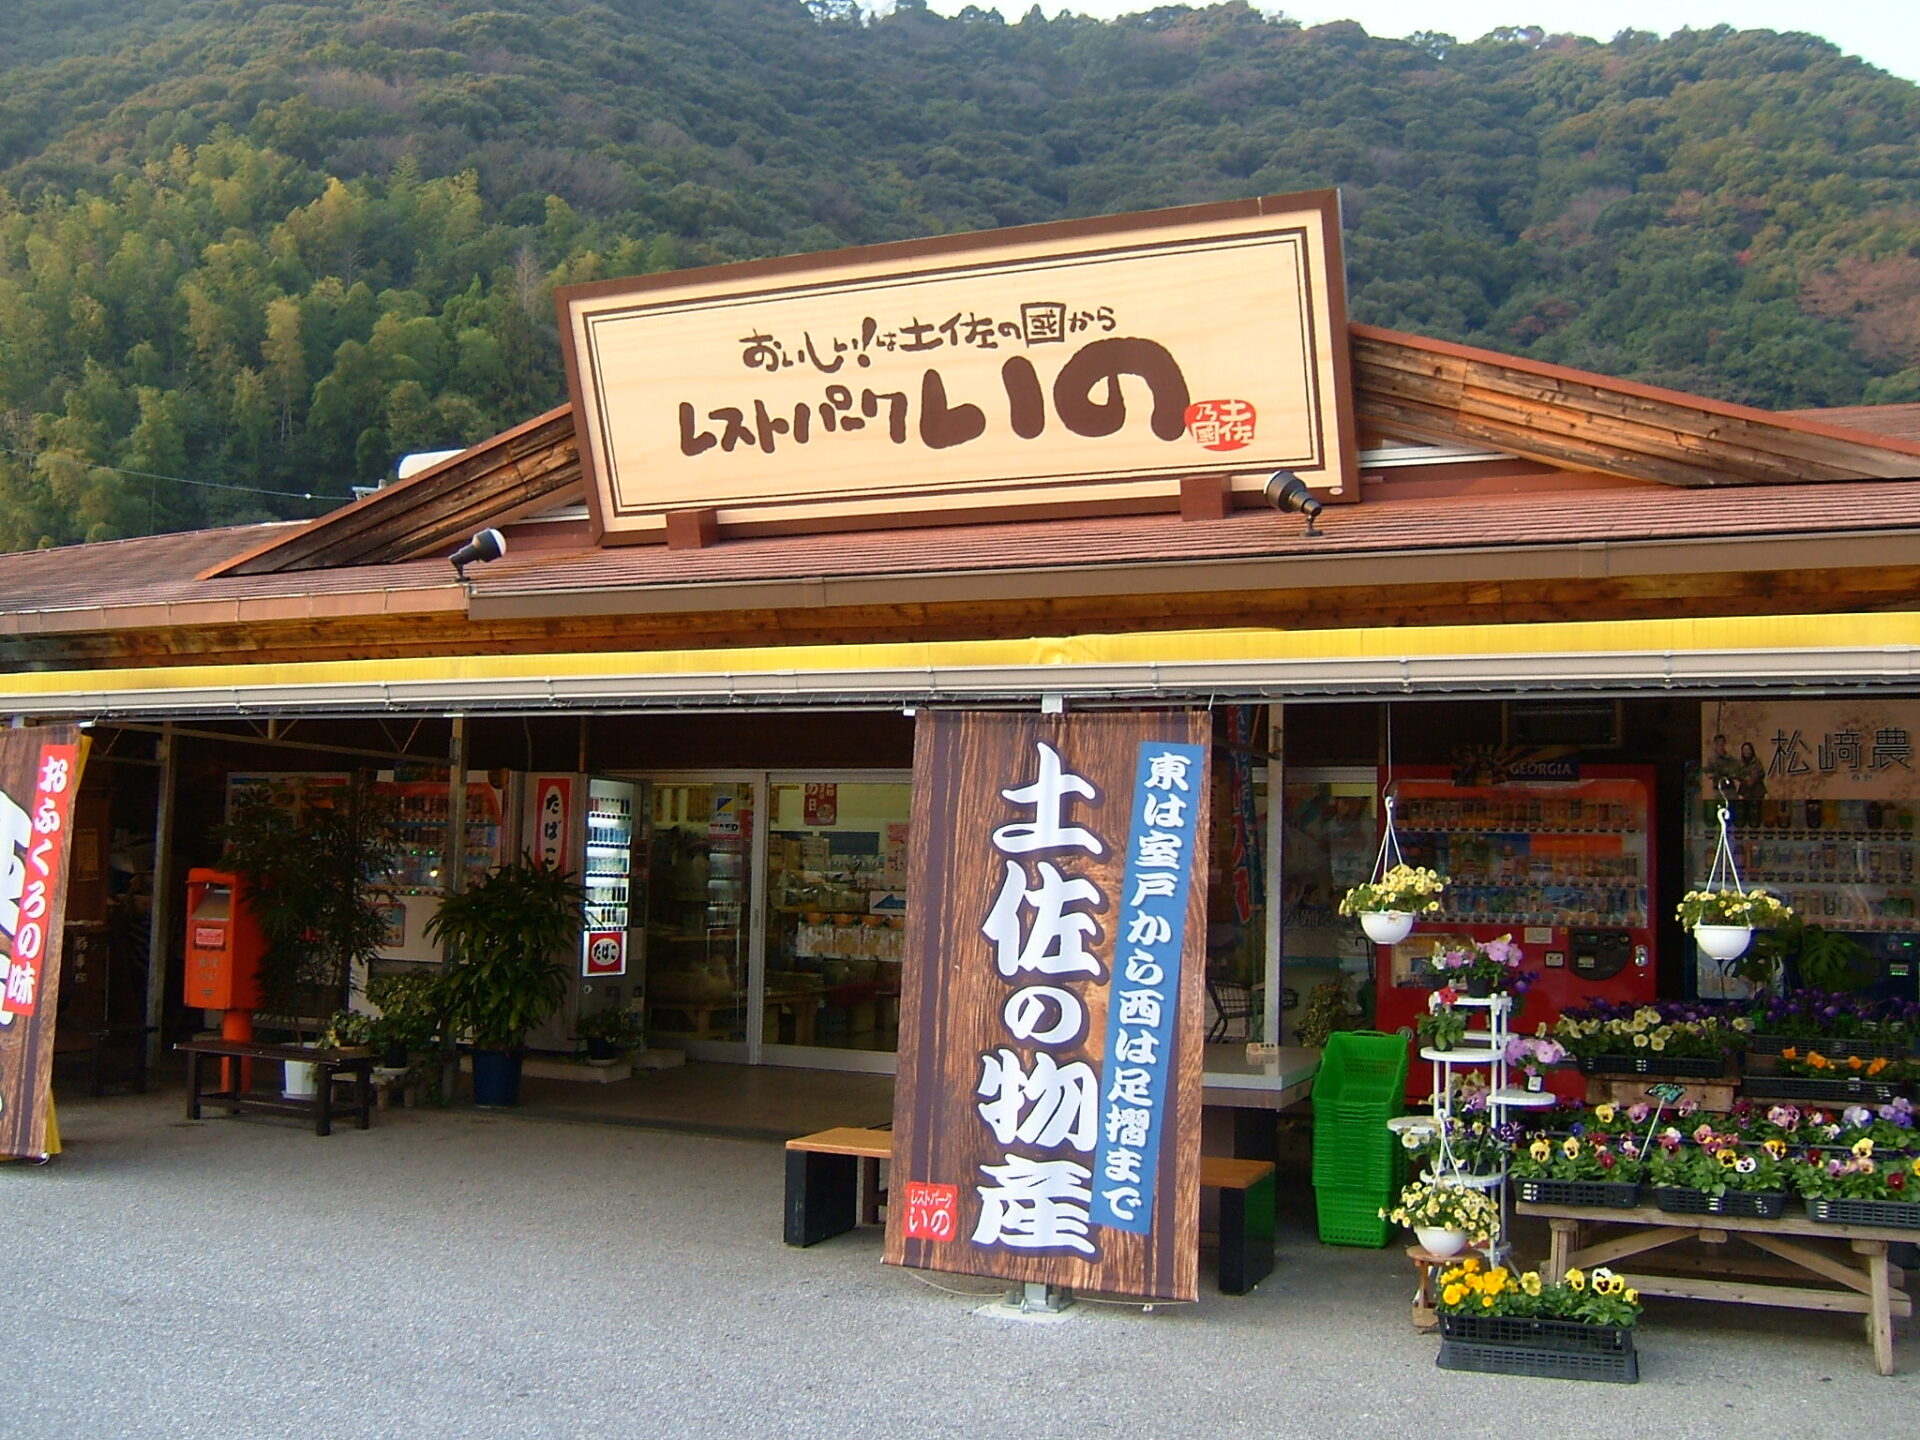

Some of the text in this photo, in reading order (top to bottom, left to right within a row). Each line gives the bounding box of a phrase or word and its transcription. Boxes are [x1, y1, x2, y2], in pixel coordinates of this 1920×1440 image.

[680, 336, 1191, 458] レストパークいの
[1510, 762, 1573, 776] GEORGIA
[545, 793, 562, 866] たばこ
[8, 756, 69, 1004] おふくろの味
[594, 943, 617, 959] たばこ
[1101, 751, 1191, 1222] 東は室戸から西は足摺まで
[970, 741, 1103, 1254] 土佐の物産
[908, 1207, 951, 1236] いの
[910, 1190, 953, 1208] レストパーク
